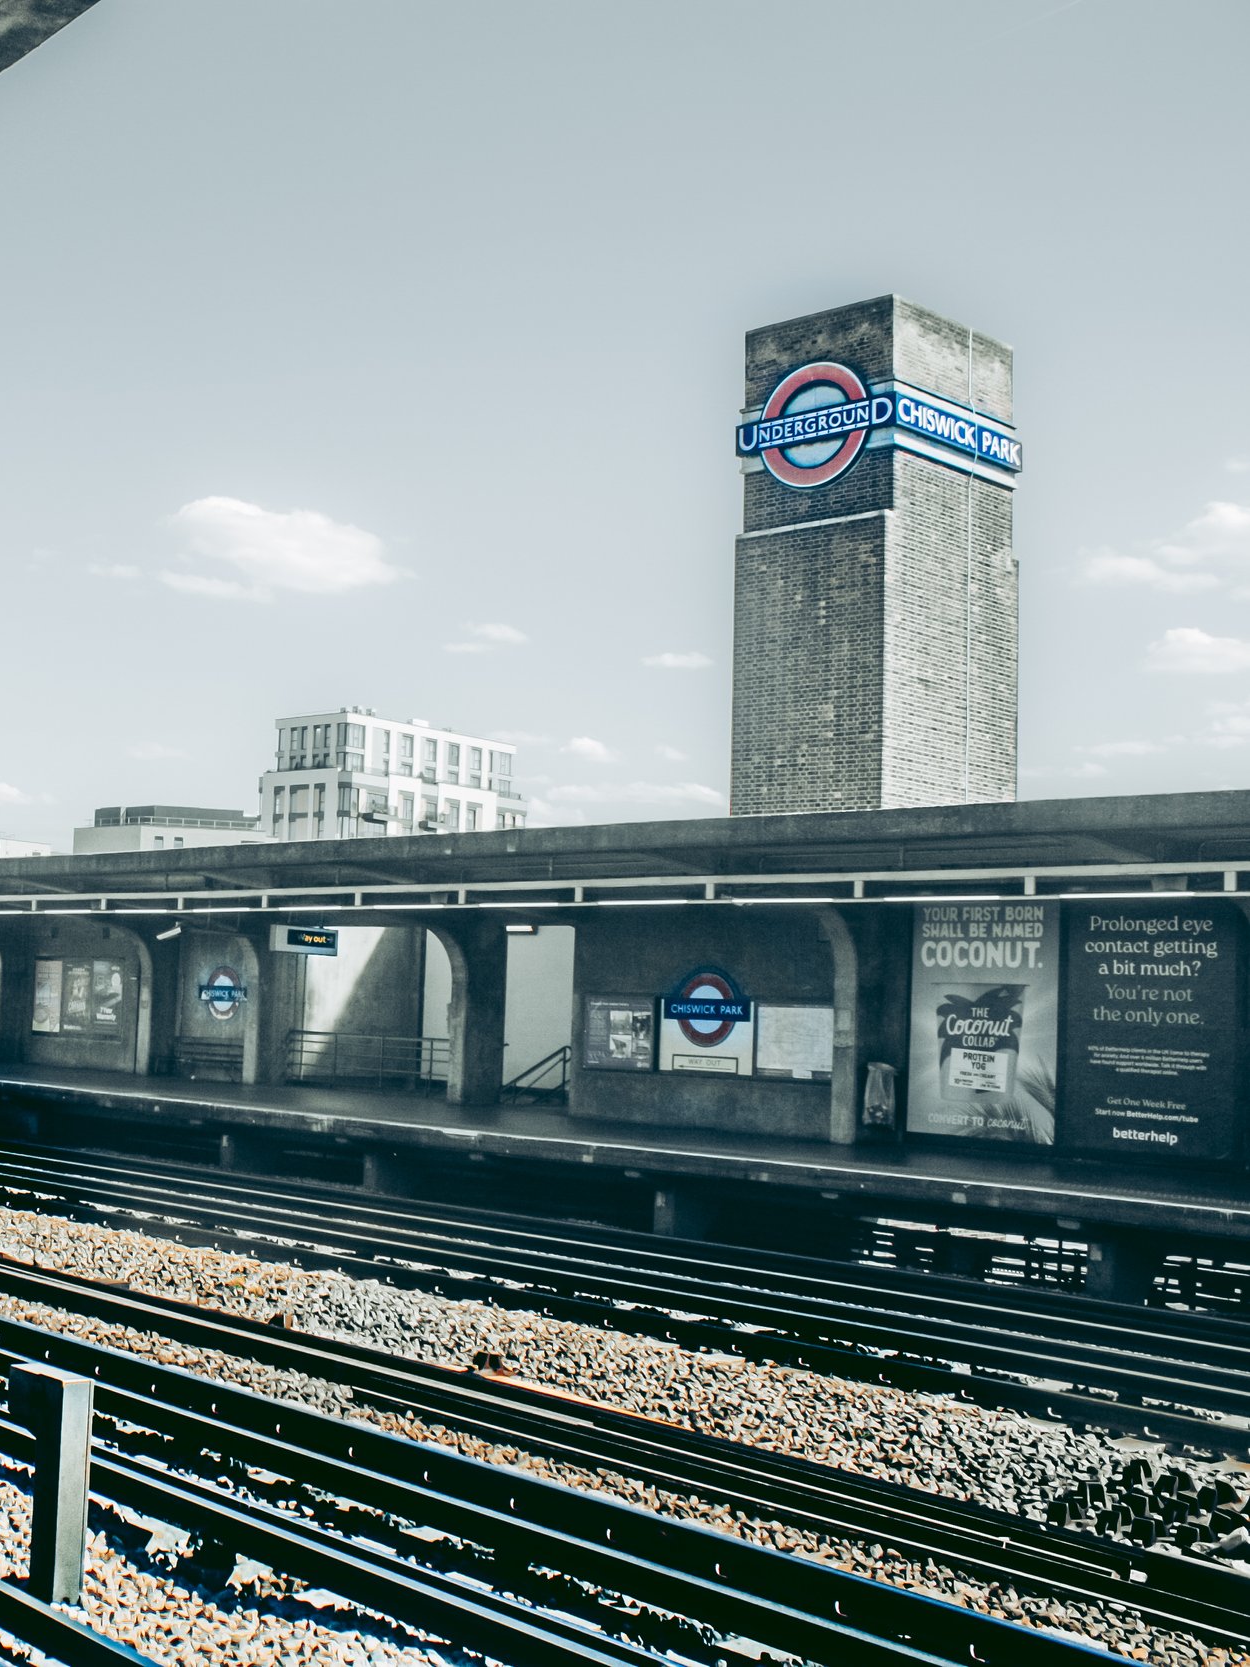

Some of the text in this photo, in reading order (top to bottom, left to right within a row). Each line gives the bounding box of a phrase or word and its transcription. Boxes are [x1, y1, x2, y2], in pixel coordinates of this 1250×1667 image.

[738, 397, 893, 451] UNDERGROUND
[897, 398, 1021, 466] CHISWICK PARK
[923, 905, 1043, 921] YOUR FIRST BORN
[922, 922, 1044, 938] SHALL BE NAMED
[1090, 915, 1213, 935] Prolonged eye
[921, 940, 1043, 969] COCONUT.
[1085, 939, 1218, 958] contact getting
[1098, 959, 1201, 976] a bit much?
[1105, 983, 1194, 1001] You're not
[671, 1003, 744, 1015] CHISWICK PARK
[971, 1007, 990, 1018] THE
[1093, 1005, 1205, 1027] the only one.
[946, 1013, 1014, 1037] Coconut
[962, 1035, 996, 1048] COLLAB
[963, 1051, 995, 1063] PROTEIN
[971, 1061, 987, 1070] YOG
[1107, 1096, 1187, 1110] Get One Week Free
[1095, 1108, 1111, 1116] Start
[971, 1116, 984, 1126] TO
[987, 1116, 1028, 1130] coconut
[1112, 1126, 1178, 1146] betterhelp
